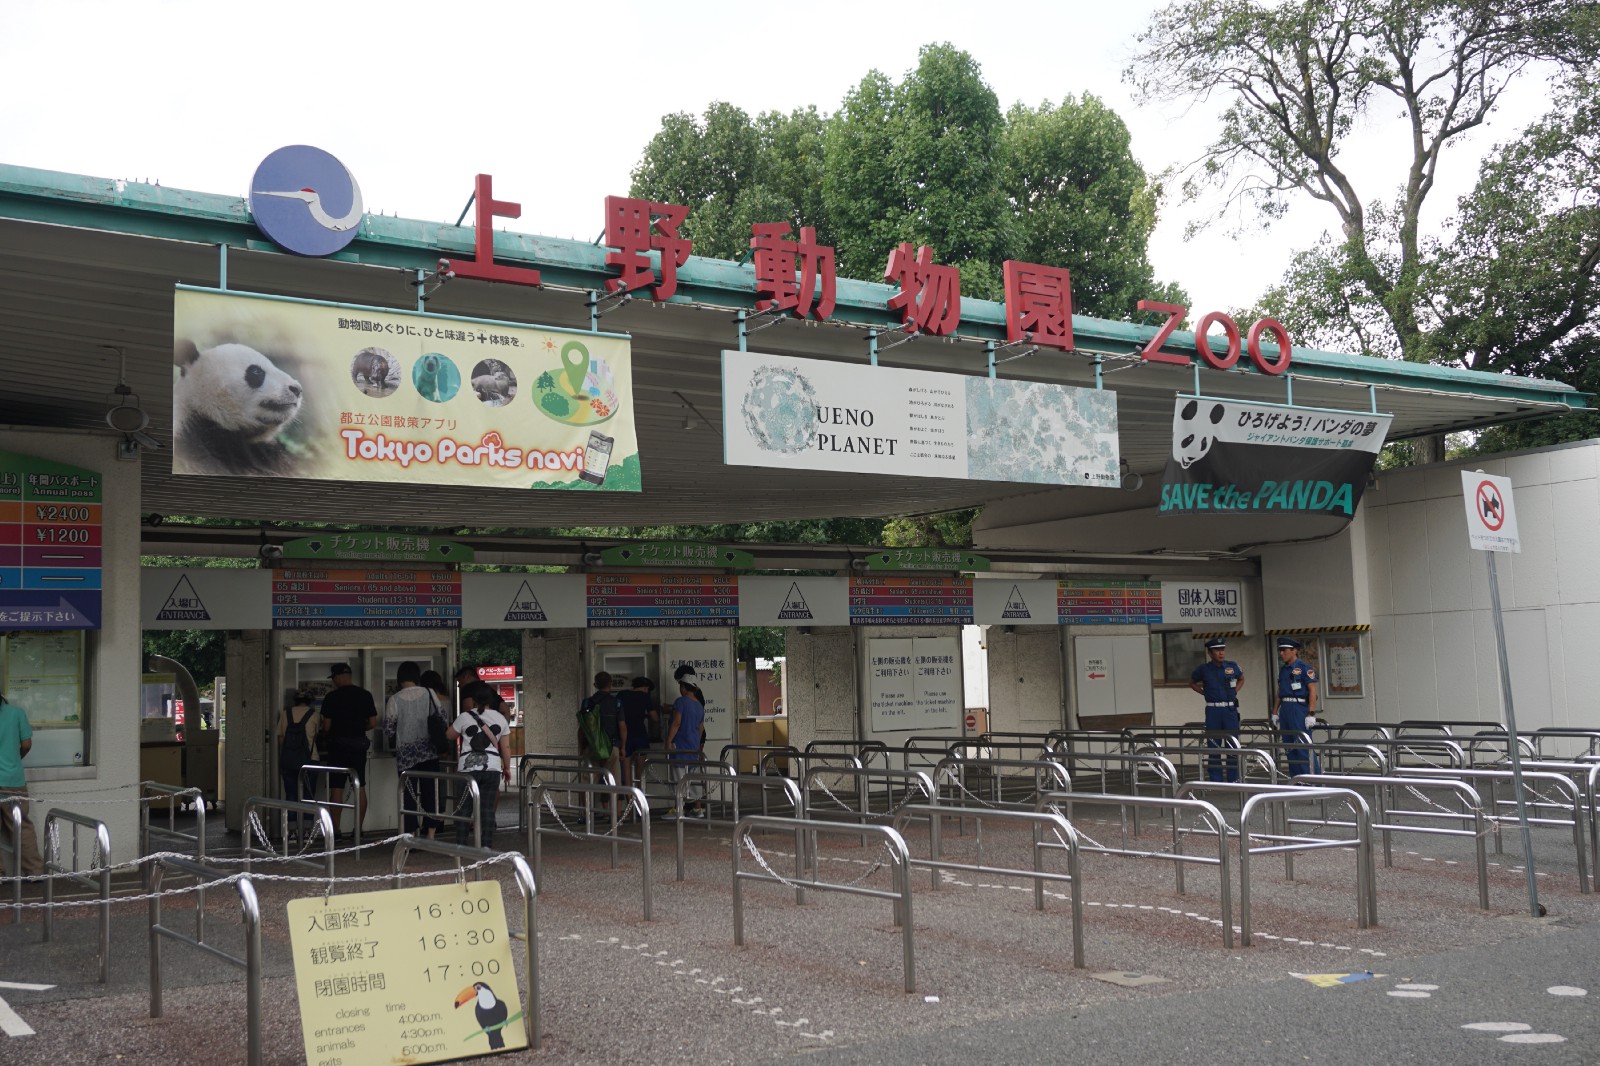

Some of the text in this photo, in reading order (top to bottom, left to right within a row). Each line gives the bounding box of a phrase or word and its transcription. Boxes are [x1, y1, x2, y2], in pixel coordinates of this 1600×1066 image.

[437, 174, 1293, 376] 上野動物園 ZOO
[340, 411, 458, 430] 都立公園散策アプリ
[816, 406, 875, 428] UENO
[340, 428, 585, 472] Tokyo Parks navi
[817, 433, 898, 456] PLANET
[29, 474, 98, 488] 年間パスポート
[0, 487, 94, 497] ore) Annual pass
[1159, 479, 1353, 515] SAVE the PANDA
[36, 506, 89, 521] ¥2400
[36, 527, 89, 543] ¥1200
[330, 535, 430, 551] チケット販売機
[638, 544, 718, 559] チケット販売機
[277, 583, 288, 591] 65
[168, 597, 199, 609] 入場口
[277, 595, 299, 603] 中学生
[1178, 588, 1238, 606] 団体入場口
[513, 601, 538, 611] 入場口
[784, 601, 805, 610] 入場口
[1007, 602, 1025, 610] 入場口
[1180, 607, 1238, 618] GROUP ENTRANCE
[160, 610, 206, 620] ENTRANCE
[507, 612, 544, 621] ENTRANCE
[780, 611, 811, 619] ENTRANCE
[1003, 610, 1030, 618] ENTRANCE
[875, 668, 909, 677] ご利用下さい
[413, 898, 490, 920] 16:00
[308, 909, 374, 933] 入園終了
[418, 928, 495, 951] 16:30
[310, 940, 379, 965] 観覧終了
[423, 959, 500, 983] 17:00
[314, 972, 386, 998] 閉園時間
[335, 1002, 406, 1019] closing time
[314, 1023, 366, 1038] entrances
[316, 1038, 356, 1054] animals
[318, 1056, 343, 1066] exits
